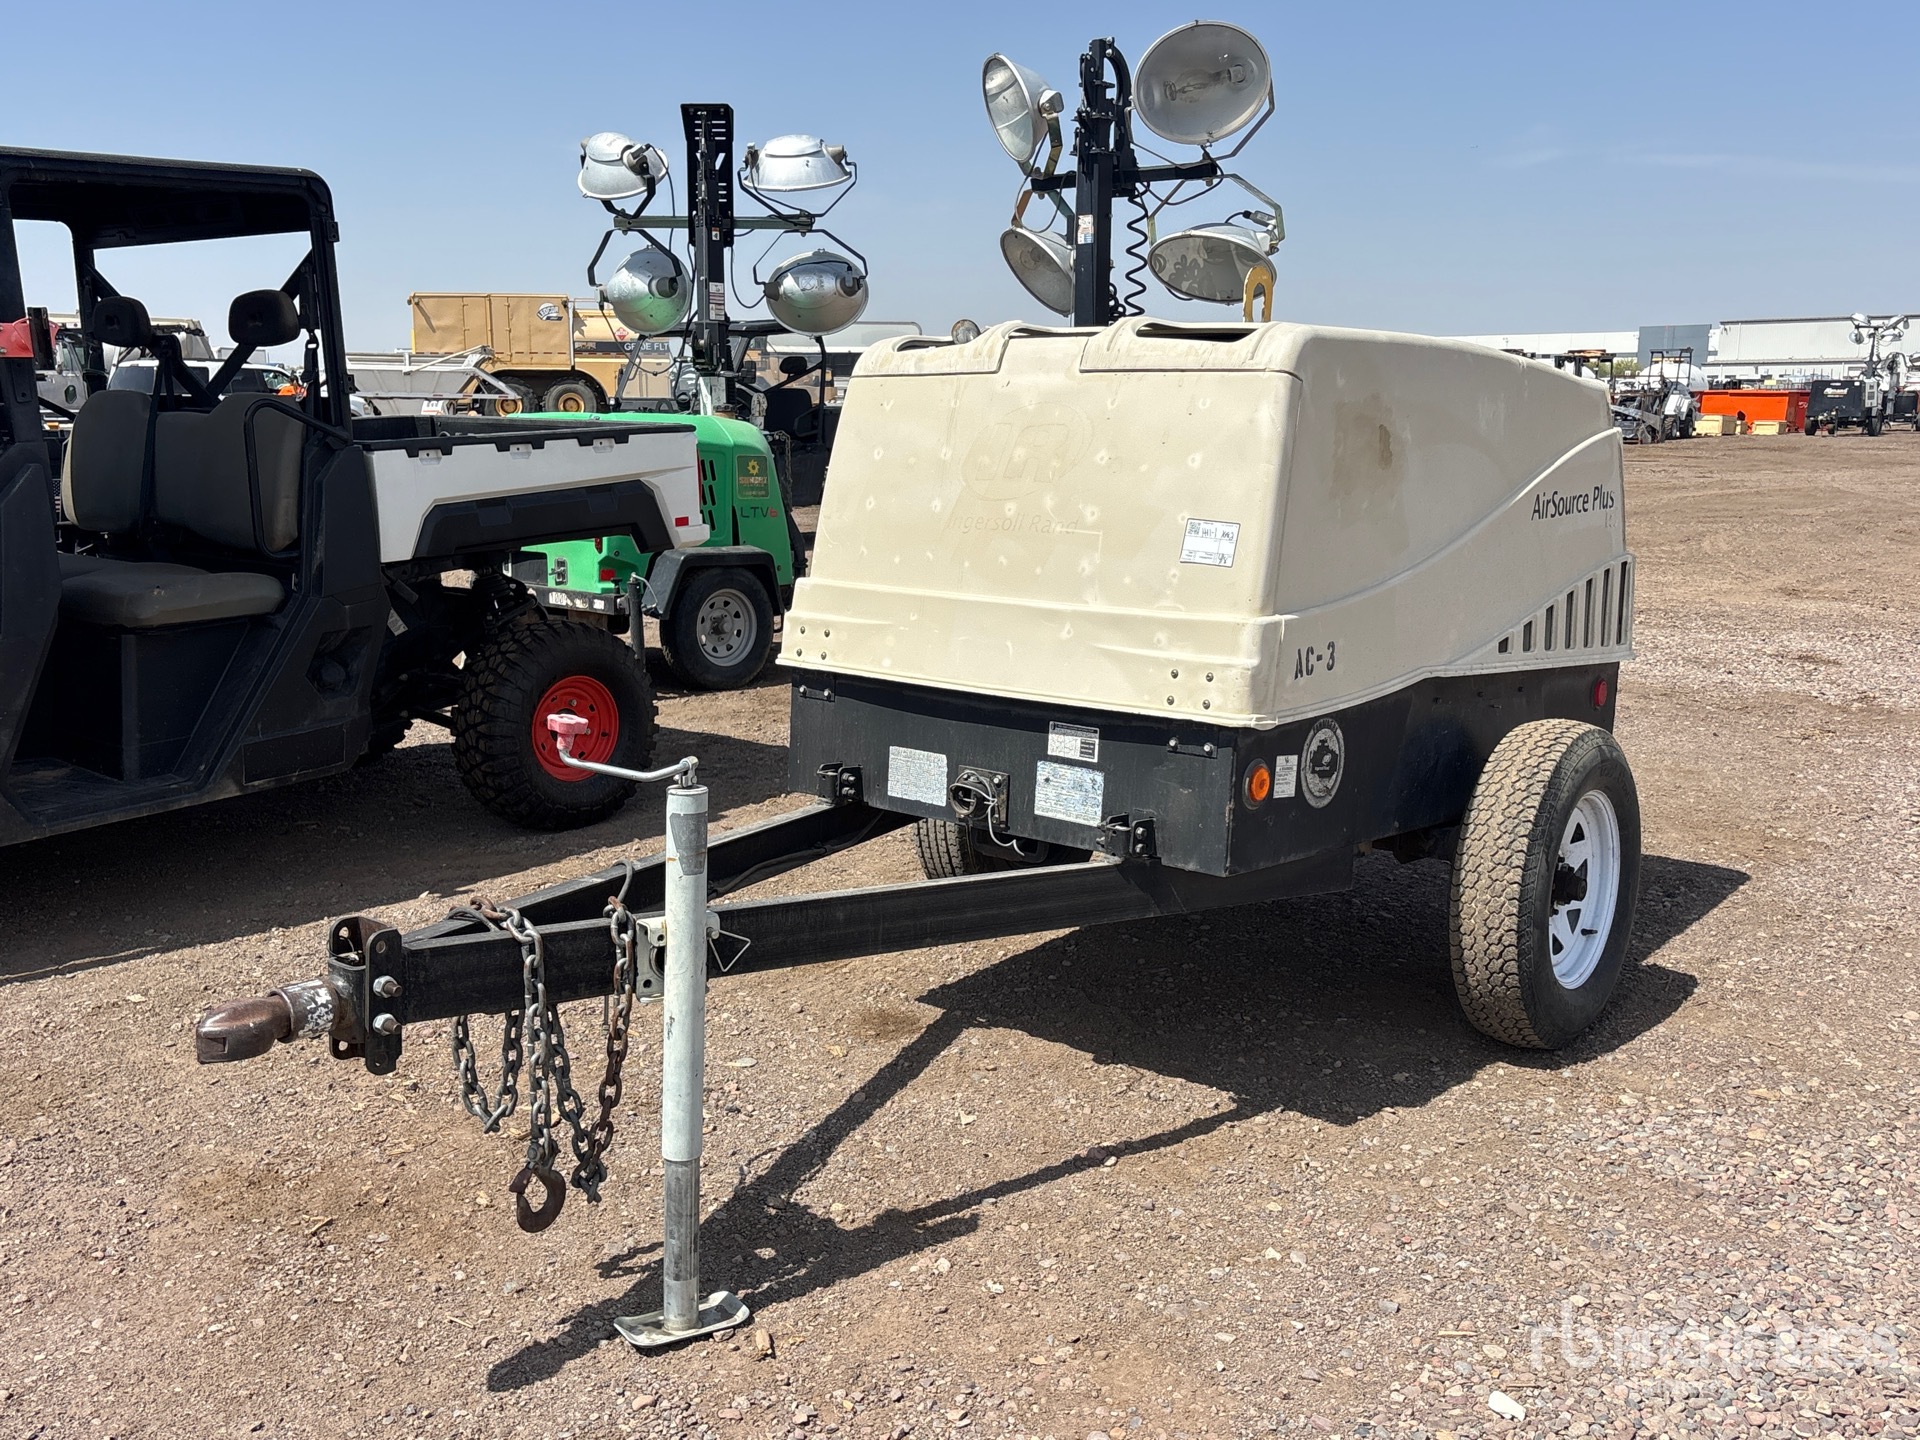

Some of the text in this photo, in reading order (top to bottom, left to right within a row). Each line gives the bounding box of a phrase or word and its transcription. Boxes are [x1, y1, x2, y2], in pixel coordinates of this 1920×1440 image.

[654, 342, 669, 351] FLT
[1531, 490, 1589, 521] AirSource
[1592, 484, 1615, 511] Plus
[1028, 513, 1080, 536] Rand
[1294, 641, 1336, 680] AC-3
